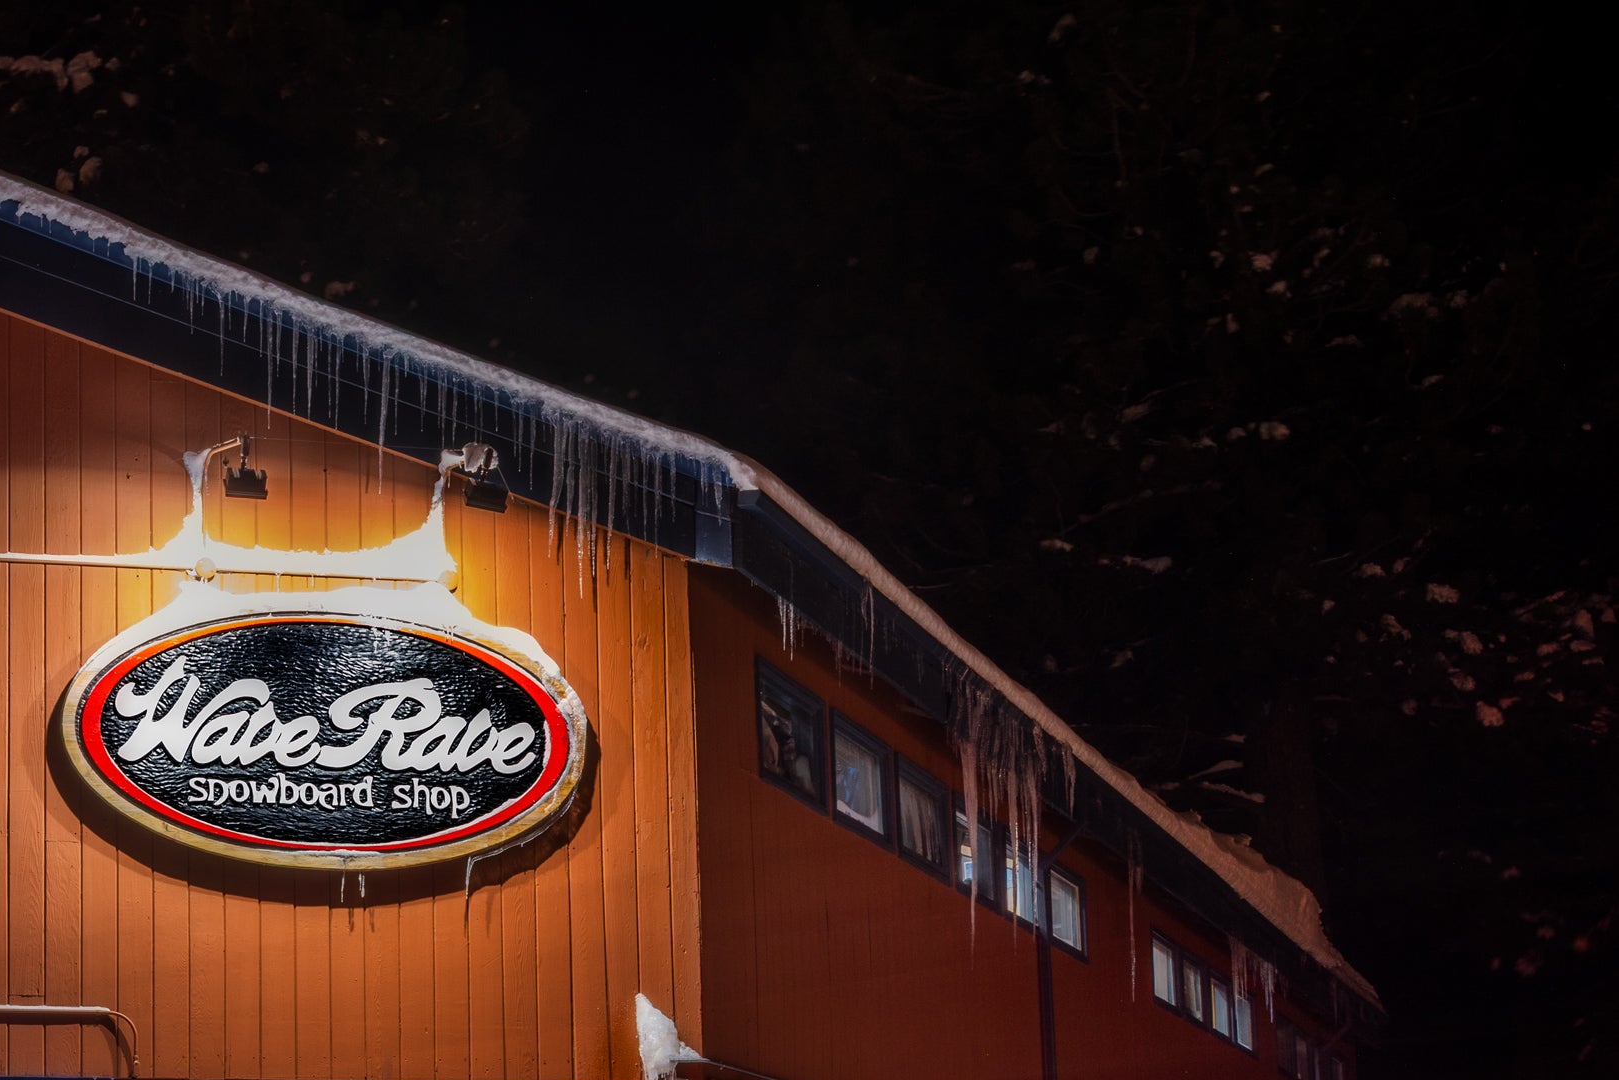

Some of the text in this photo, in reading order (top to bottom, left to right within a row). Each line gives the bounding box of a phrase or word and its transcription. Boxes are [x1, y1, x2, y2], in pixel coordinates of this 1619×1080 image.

[115, 655, 536, 774] Wave Rave
[188, 772, 471, 819] snowboard shop
